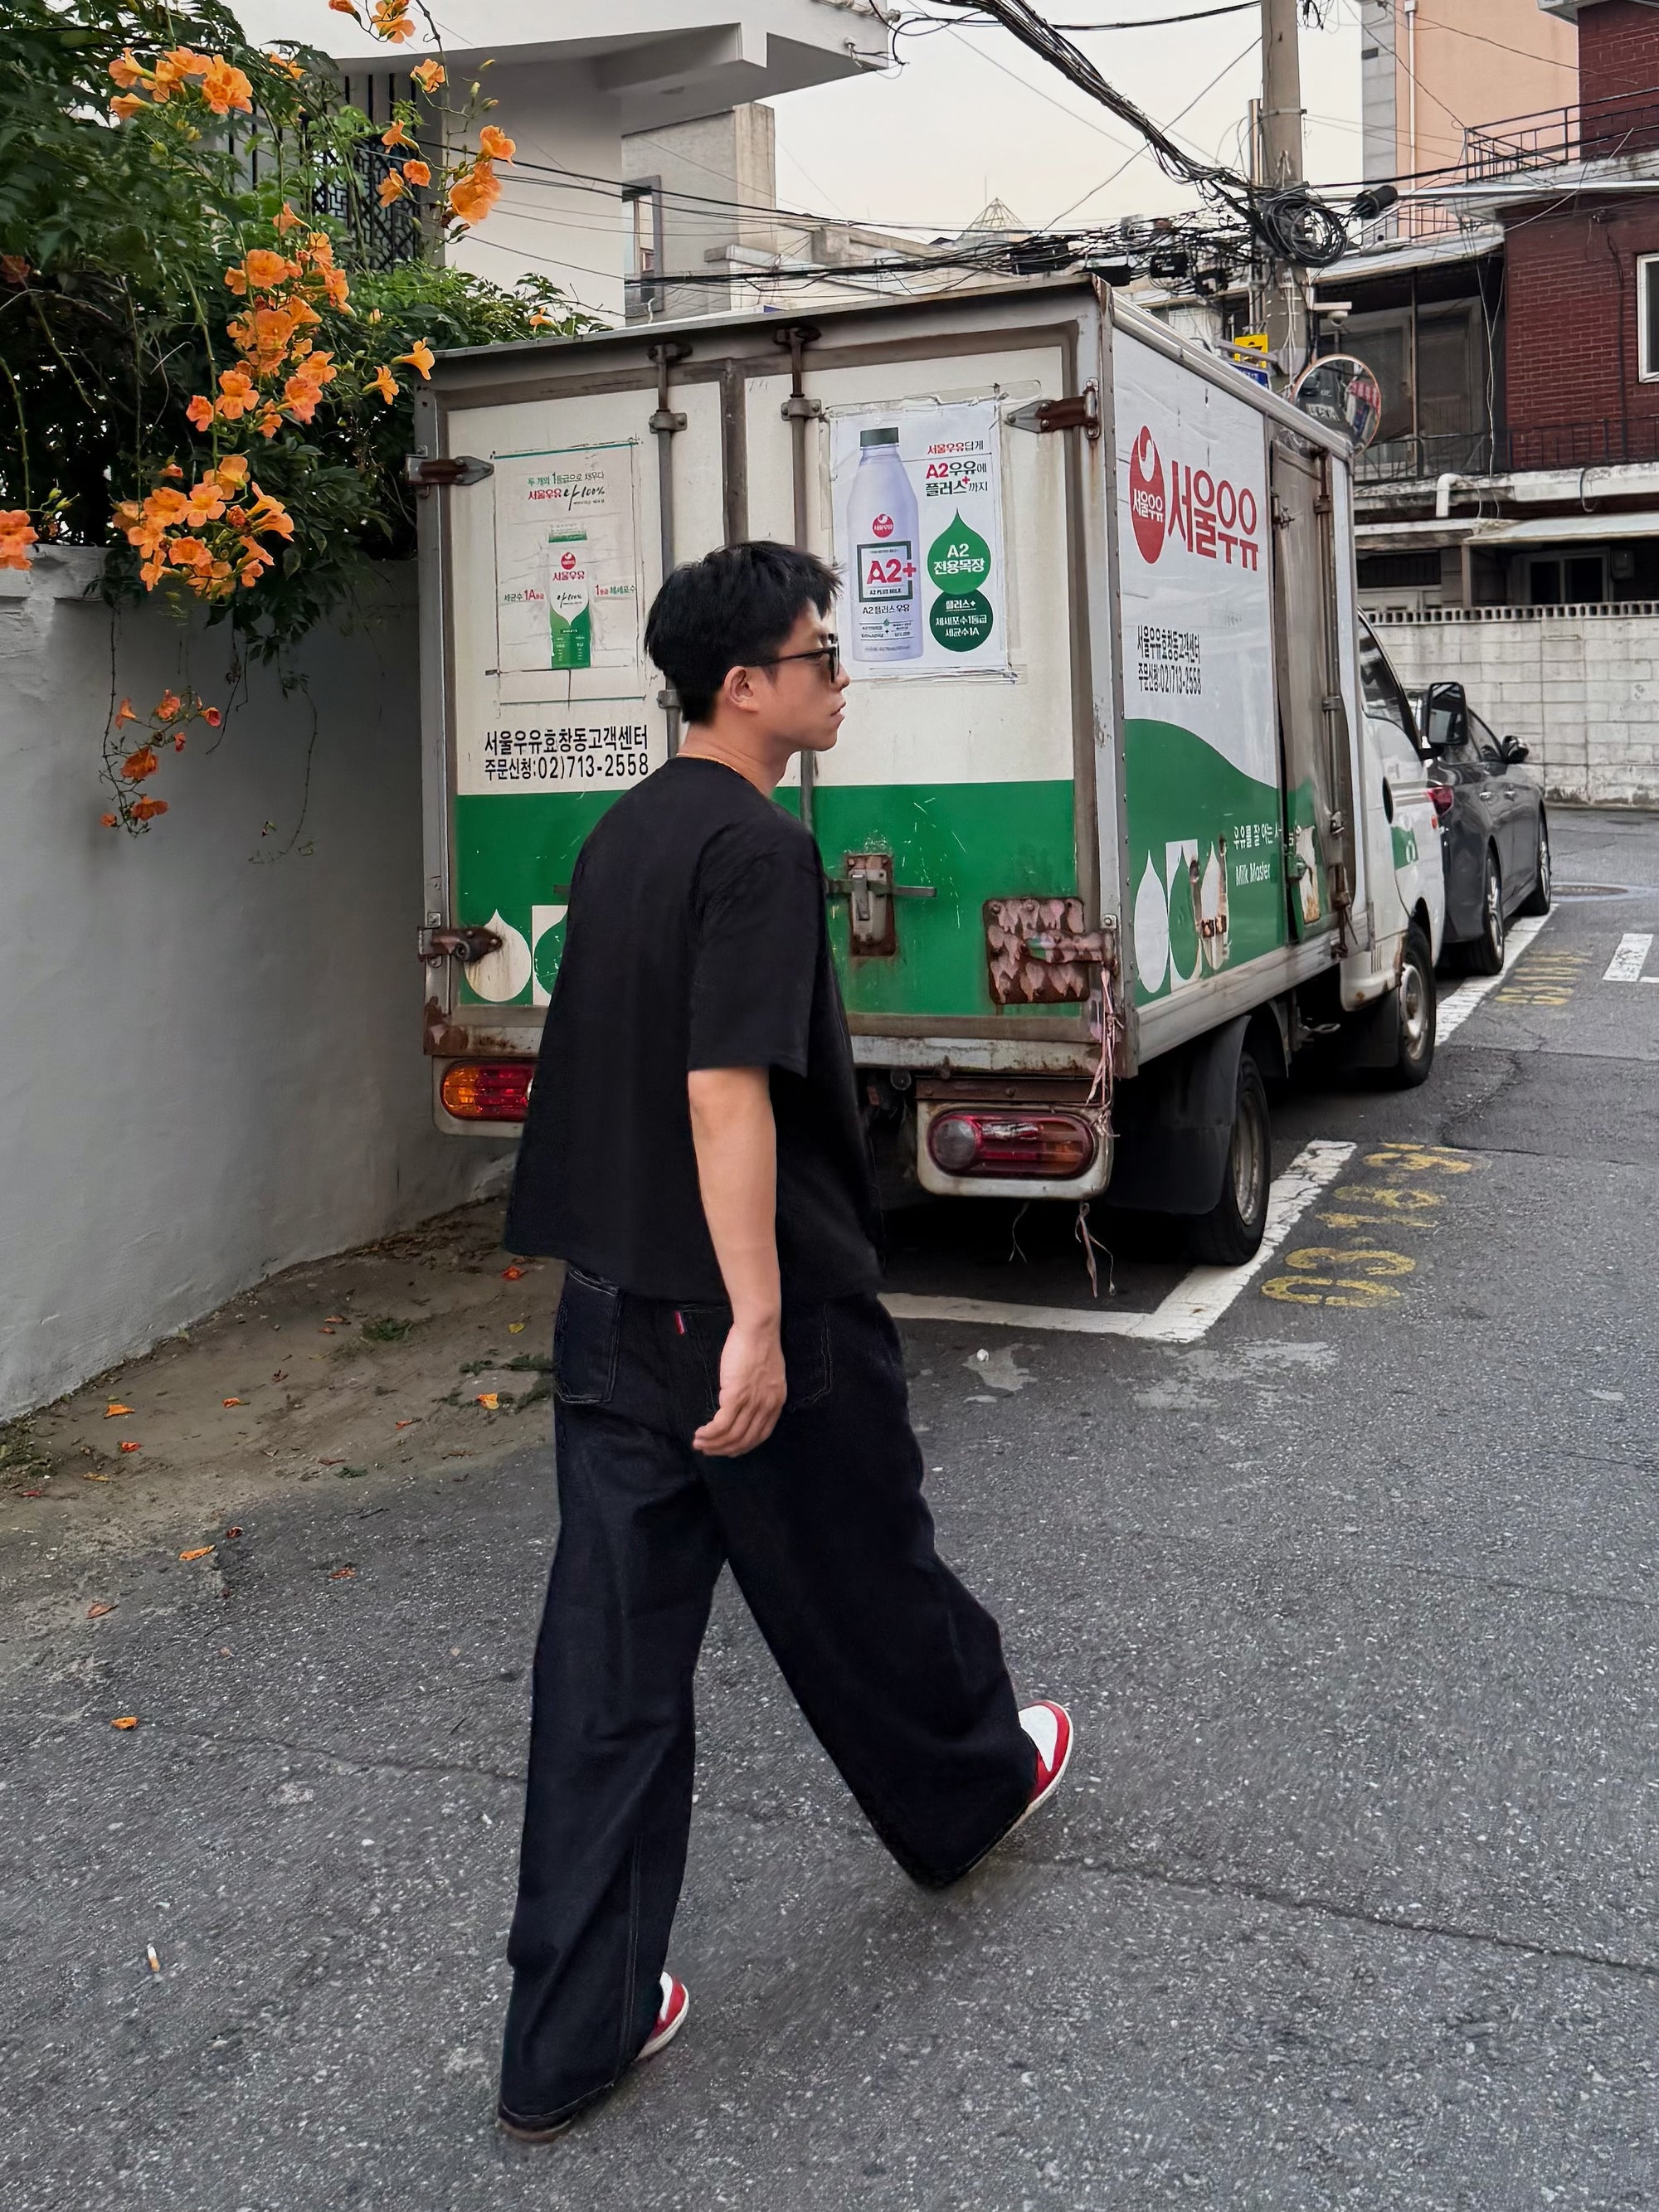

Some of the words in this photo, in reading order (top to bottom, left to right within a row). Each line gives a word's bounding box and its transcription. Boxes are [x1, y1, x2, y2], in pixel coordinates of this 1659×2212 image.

[926, 461, 987, 479] A2우유에
[528, 488, 562, 500] 서울우유
[1133, 489, 1163, 523] 서울우유
[1167, 460, 1258, 571] 서울우유
[947, 543, 969, 558] A2
[933, 558, 985, 575] 전용목장
[484, 724, 649, 756] 서울우유효창동고객센터
[484, 752, 649, 781] 주문신청:02)713-2558
[1249, 861, 1271, 883] Master
